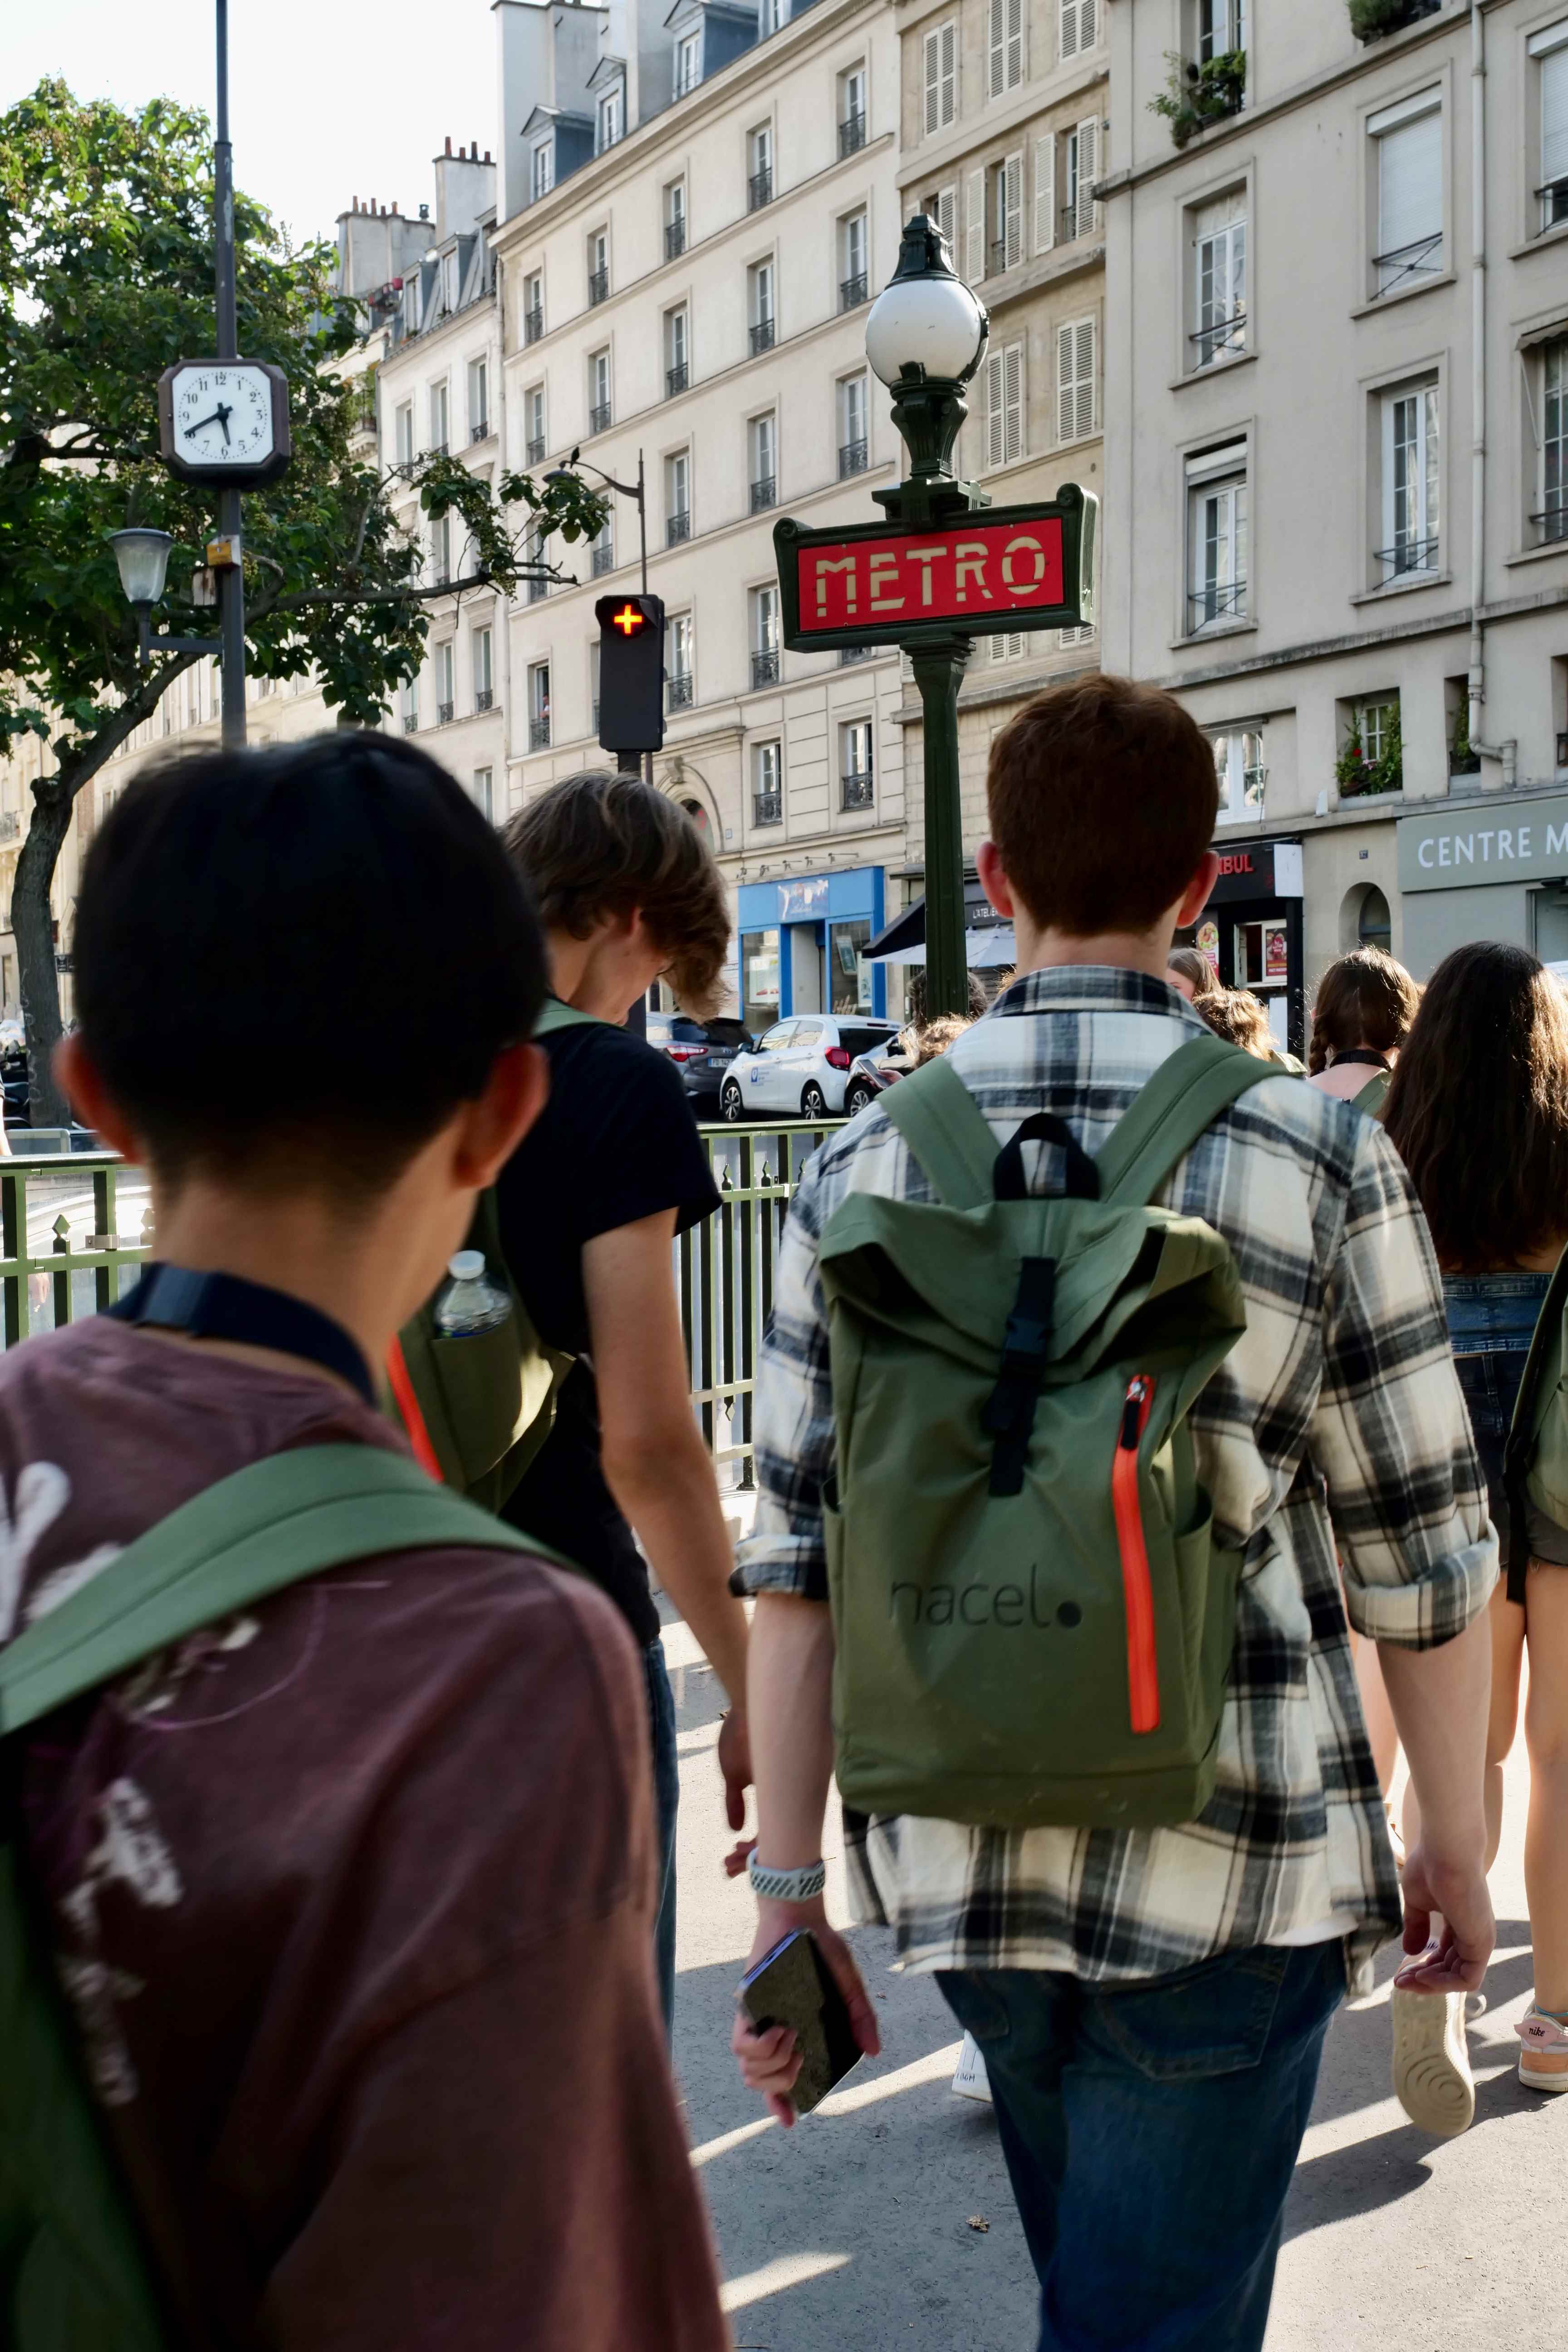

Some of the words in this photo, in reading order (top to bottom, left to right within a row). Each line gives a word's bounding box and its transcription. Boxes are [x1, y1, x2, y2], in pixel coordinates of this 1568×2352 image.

[215, 374, 226, 385] 12
[199, 381, 208, 391] 11
[237, 380, 241, 390] 1
[186, 393, 198, 403] 10
[250, 392, 256, 402] 2
[183, 412, 190, 421] 9
[256, 410, 262, 420] 3
[251, 427, 259, 437] 4
[203, 441, 210, 451] 7
[238, 440, 245, 451] 5
[221, 446, 228, 456] 6
[816, 536, 1045, 617] METRO
[1418, 827, 1532, 868] CENTRE
[1529, 2027, 1545, 2037] nike
